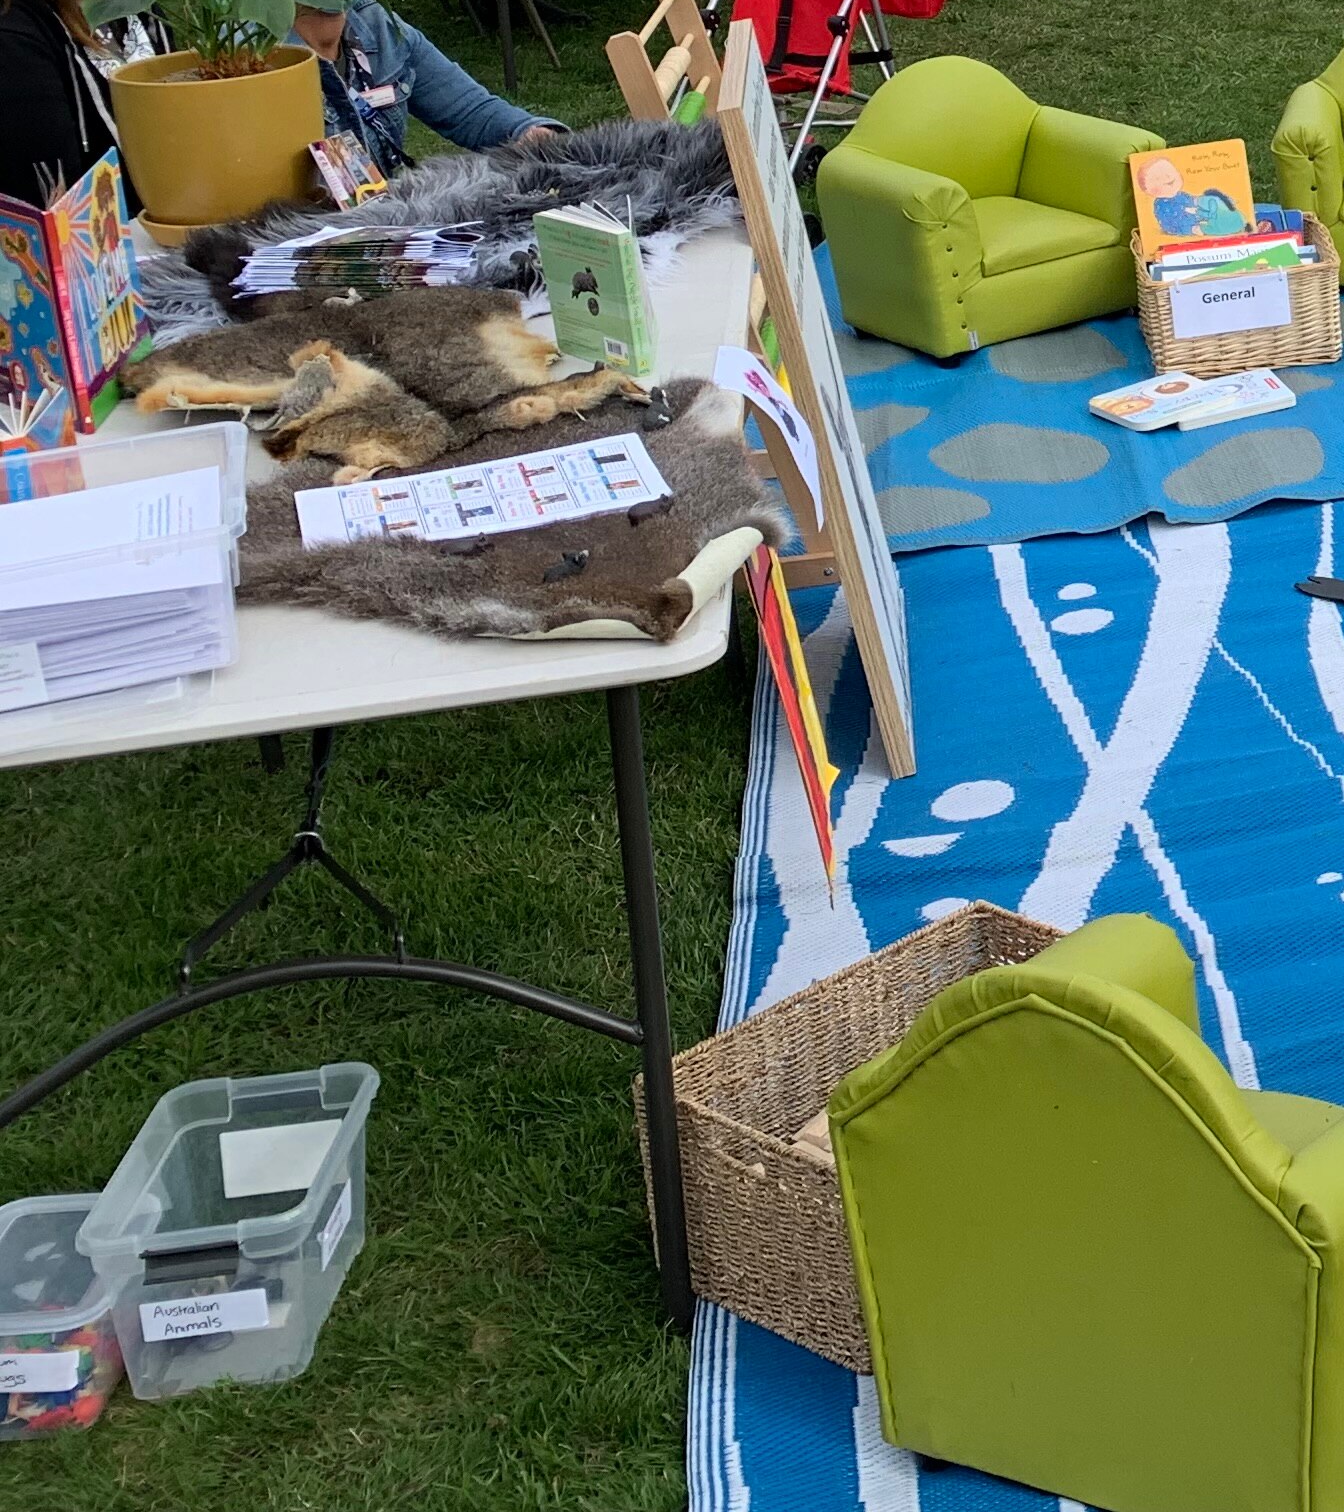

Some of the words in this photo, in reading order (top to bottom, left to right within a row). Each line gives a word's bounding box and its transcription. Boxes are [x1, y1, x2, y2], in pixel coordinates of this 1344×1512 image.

[1185, 251, 1233, 265] Possum
[1201, 286, 1256, 304] General
[153, 1301, 220, 1319] Australian
[164, 1315, 222, 1337] Animals
